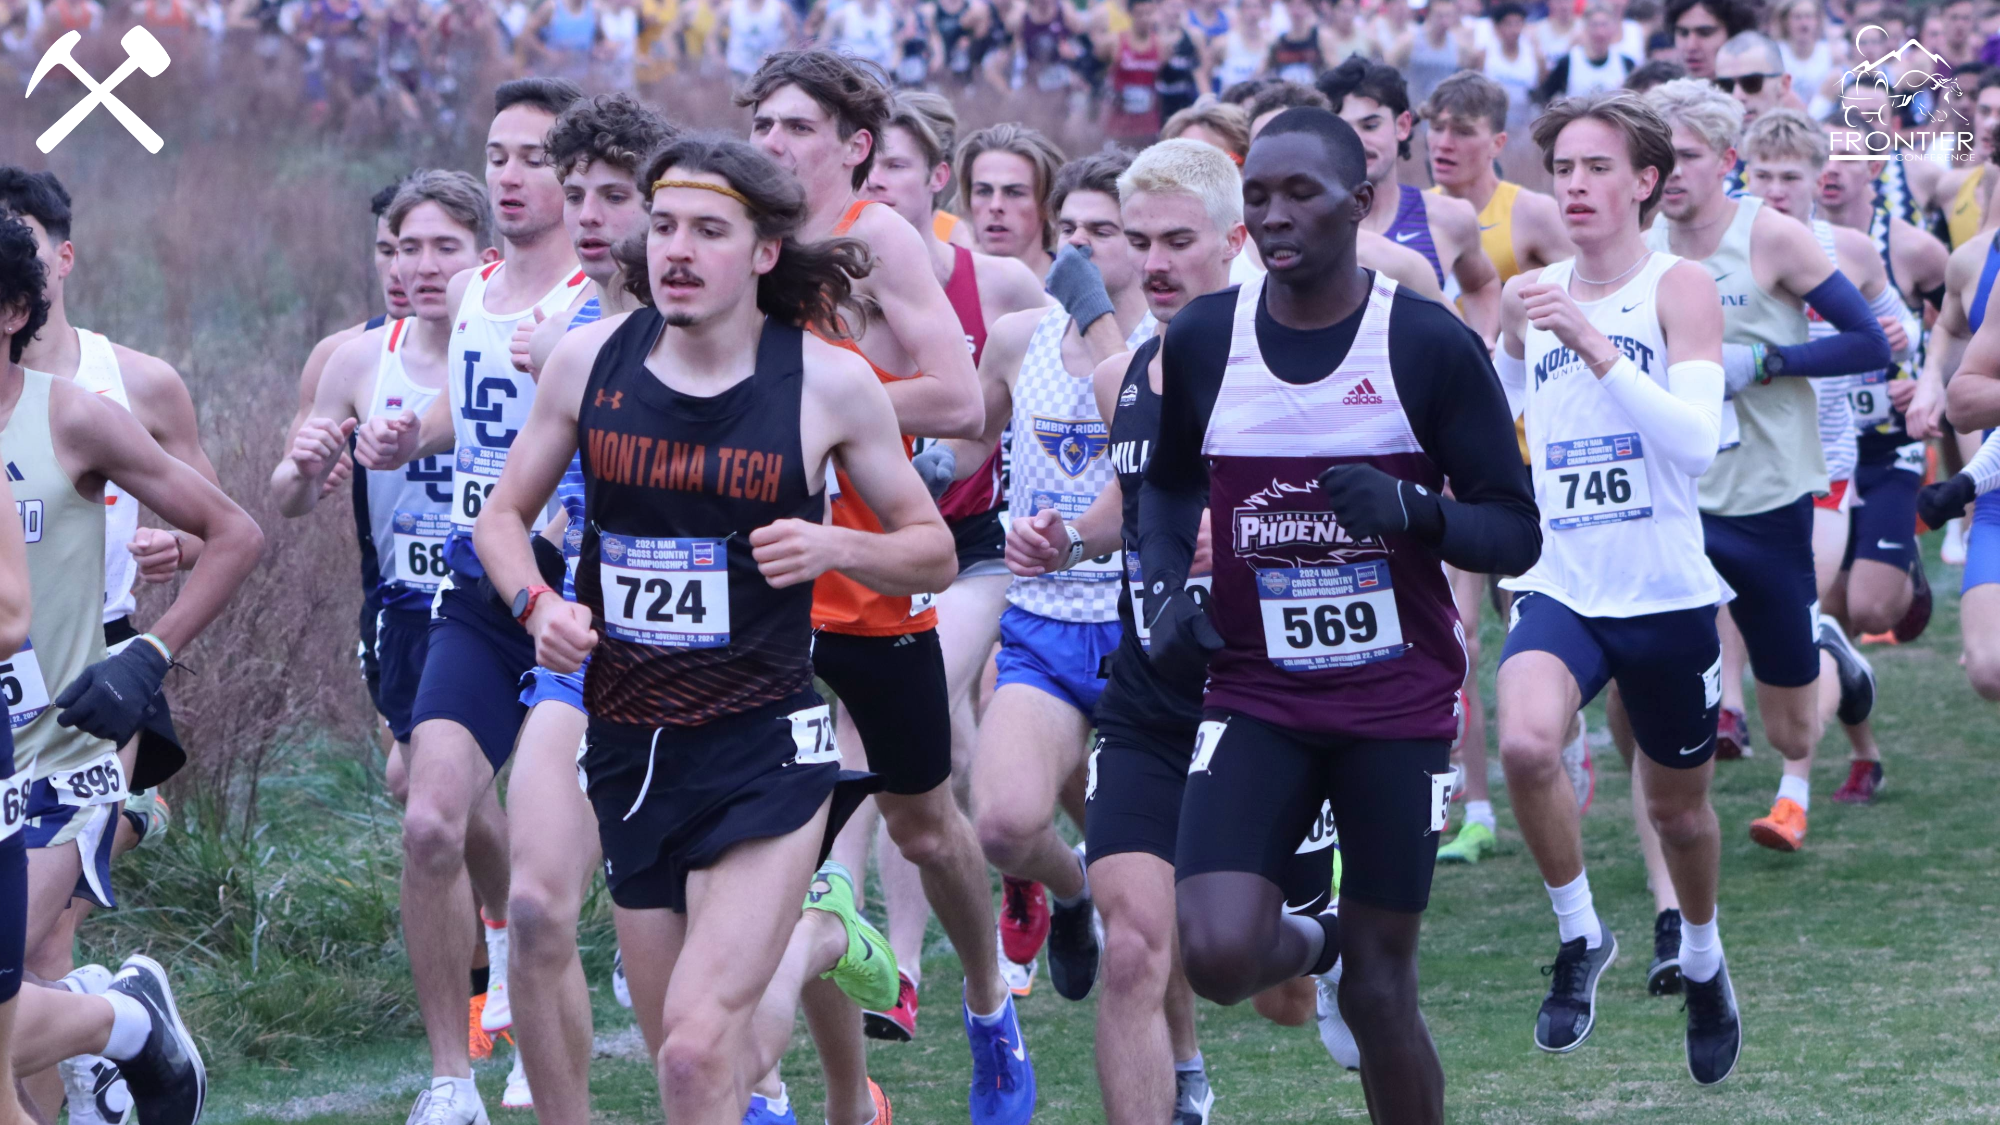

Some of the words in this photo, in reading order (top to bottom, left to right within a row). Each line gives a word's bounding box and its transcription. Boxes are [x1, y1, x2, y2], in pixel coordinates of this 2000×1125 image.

[1534, 335, 1653, 393] NOREST
[1552, 364, 1590, 380] UNIVE
[1342, 394, 1382, 405] adidas
[1035, 420, 1107, 434] EMBRY-RIDDL
[1573, 440, 1588, 448] 2024
[480, 450, 494, 458] 2024
[1111, 440, 1150, 474] MILL
[1567, 448, 1586, 458] CROSS
[1587, 446, 1612, 455] COUNTRY
[474, 457, 490, 466] CROSS
[588, 428, 705, 492] MONTANA
[717, 447, 784, 504] TECH
[1559, 468, 1632, 510] 746
[463, 480, 496, 518] 6
[16, 499, 44, 544] D
[1260, 513, 1336, 523] CUMBERLAN
[1240, 516, 1372, 548] PHOEN
[635, 540, 655, 549] 2024
[657, 540, 676, 549] NAIA
[408, 542, 452, 577] 68
[627, 548, 651, 558] CROSS
[653, 550, 689, 560] COUNTRY
[627, 558, 688, 570] CHAMPIONSHIPS
[1299, 569, 1320, 578] 2024
[1321, 568, 1339, 576] NAIA
[1291, 578, 1317, 588] CROSS
[1318, 575, 1353, 587] COUNTRY
[1292, 586, 1354, 598] CHAMPIONSHIPS
[616, 575, 706, 624] 724
[1282, 601, 1378, 649] 569
[655, 632, 686, 641] NOVEMBER
[687, 634, 696, 642] 22,
[1330, 654, 1361, 663] NOVEMBER
[1374, 648, 1390, 656] 2024
[23, 711, 37, 720] 2024
[806, 716, 836, 754] 72
[67, 760, 120, 798] 895
